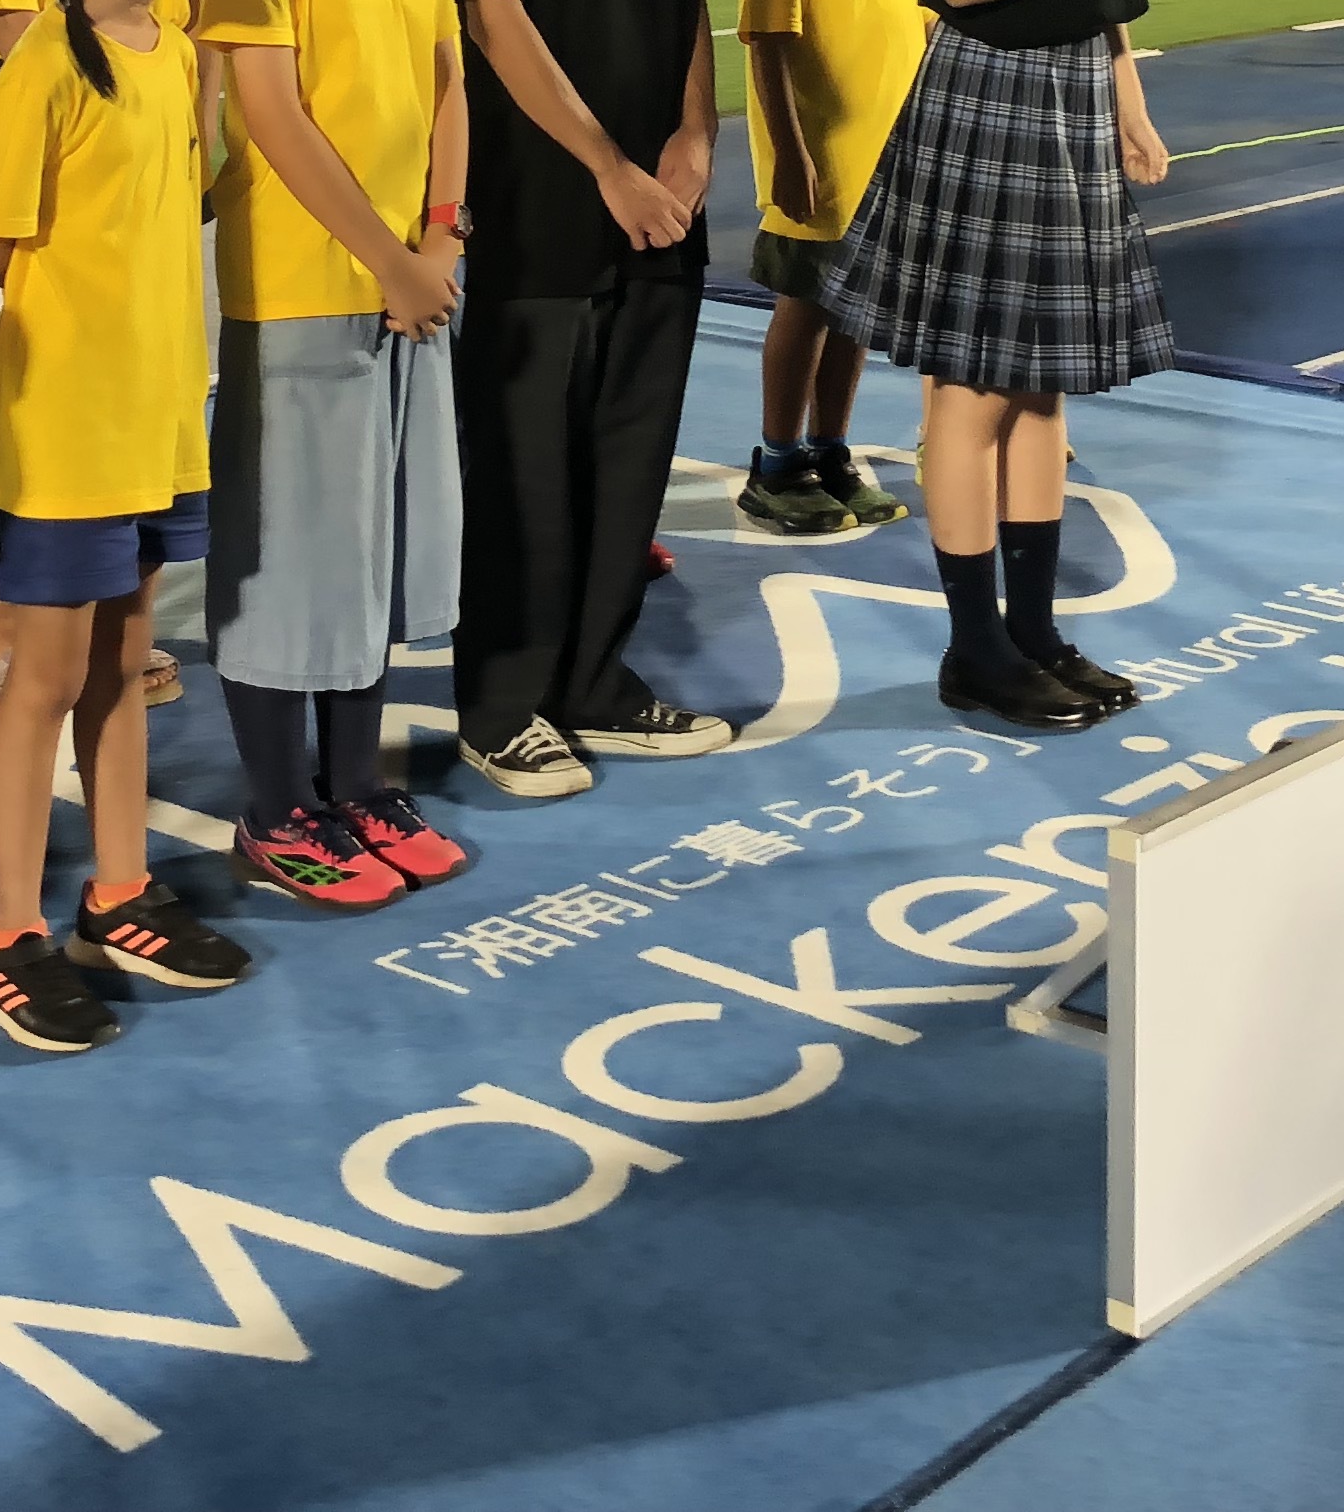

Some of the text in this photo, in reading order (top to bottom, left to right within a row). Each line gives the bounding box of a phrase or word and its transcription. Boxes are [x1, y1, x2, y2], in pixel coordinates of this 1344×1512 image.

[1115, 612, 1319, 702] atural
[373, 724, 1042, 995] 「湘南に暮らそう」
